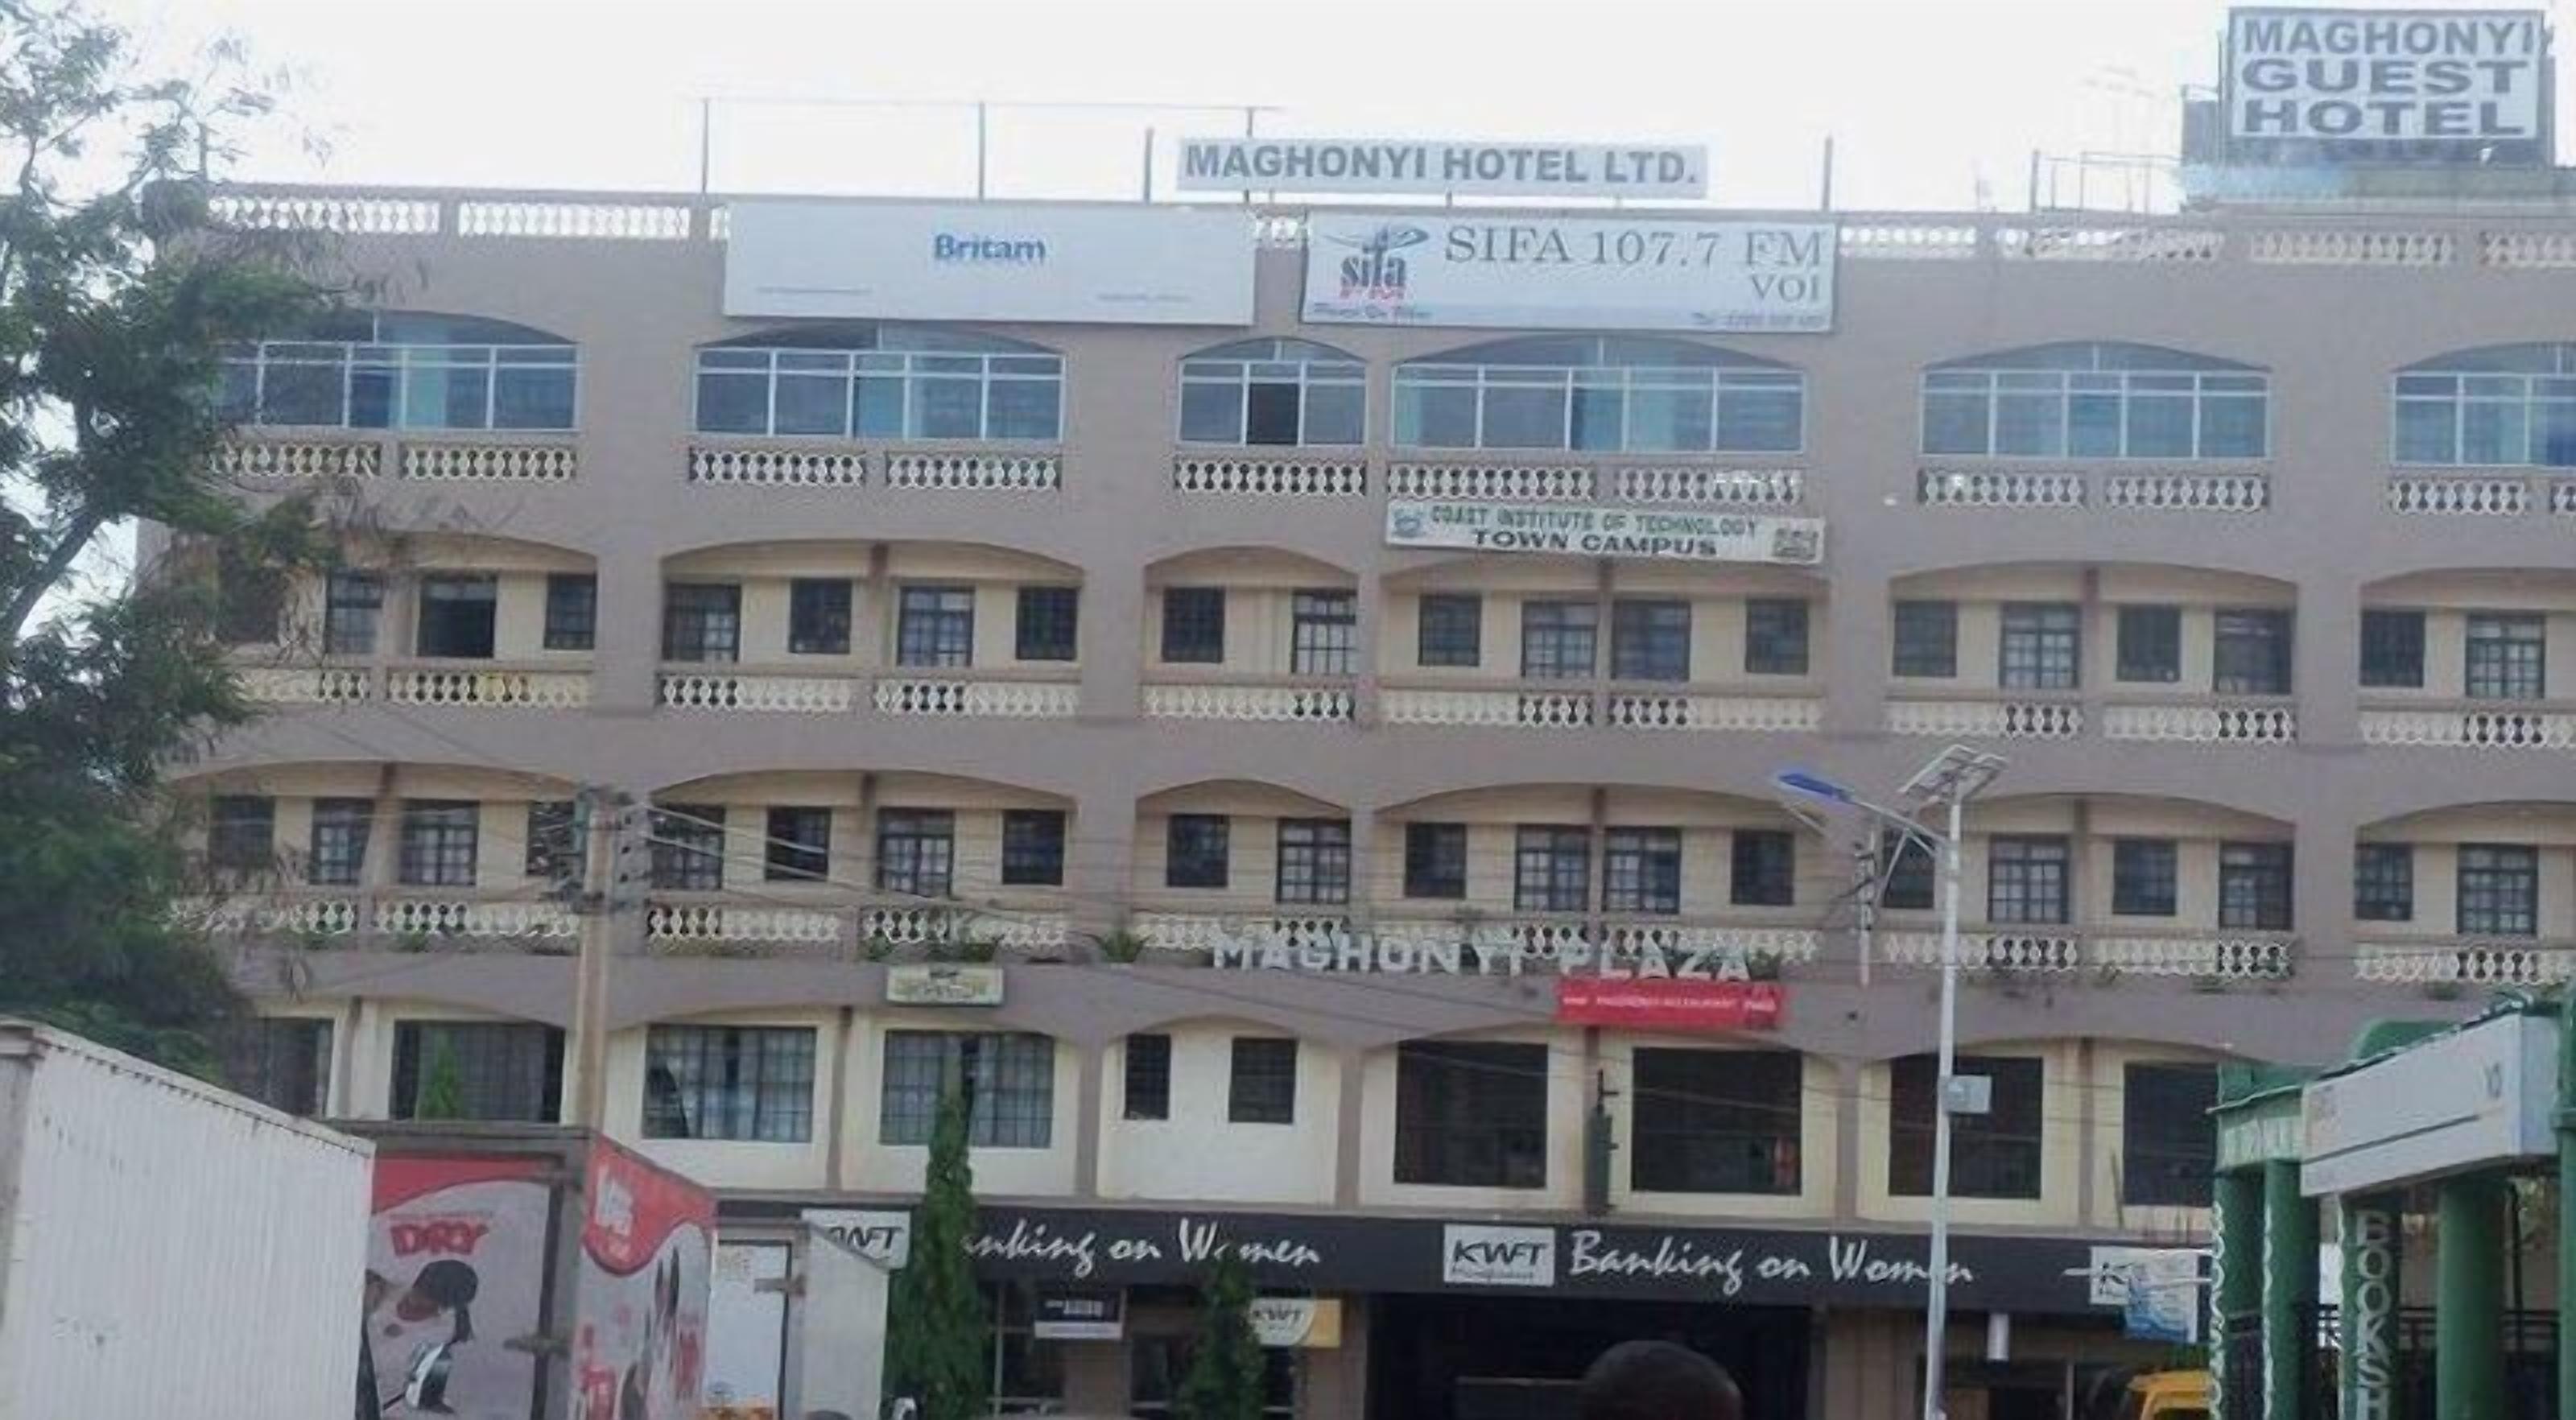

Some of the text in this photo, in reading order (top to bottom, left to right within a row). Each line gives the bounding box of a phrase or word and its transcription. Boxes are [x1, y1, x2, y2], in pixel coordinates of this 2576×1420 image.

[2243, 20, 2533, 55] MAGHONYI
[2242, 59, 2529, 95] GUEST
[2244, 100, 2524, 136] HOTEL
[1186, 145, 1696, 184] MAGHONYI HOTEL LTD.
[933, 233, 1046, 262] Britam
[1446, 225, 1821, 266] SIFA 107.7 FM
[1751, 274, 1819, 303] VOI
[1474, 528, 1717, 555] TOWN CAMPUS
[1212, 932, 1750, 980] MAGHONYI PLAZA
[962, 1218, 1320, 1278] anking on Wmen
[1452, 1230, 1973, 1295] KWFT Banking on Womn
